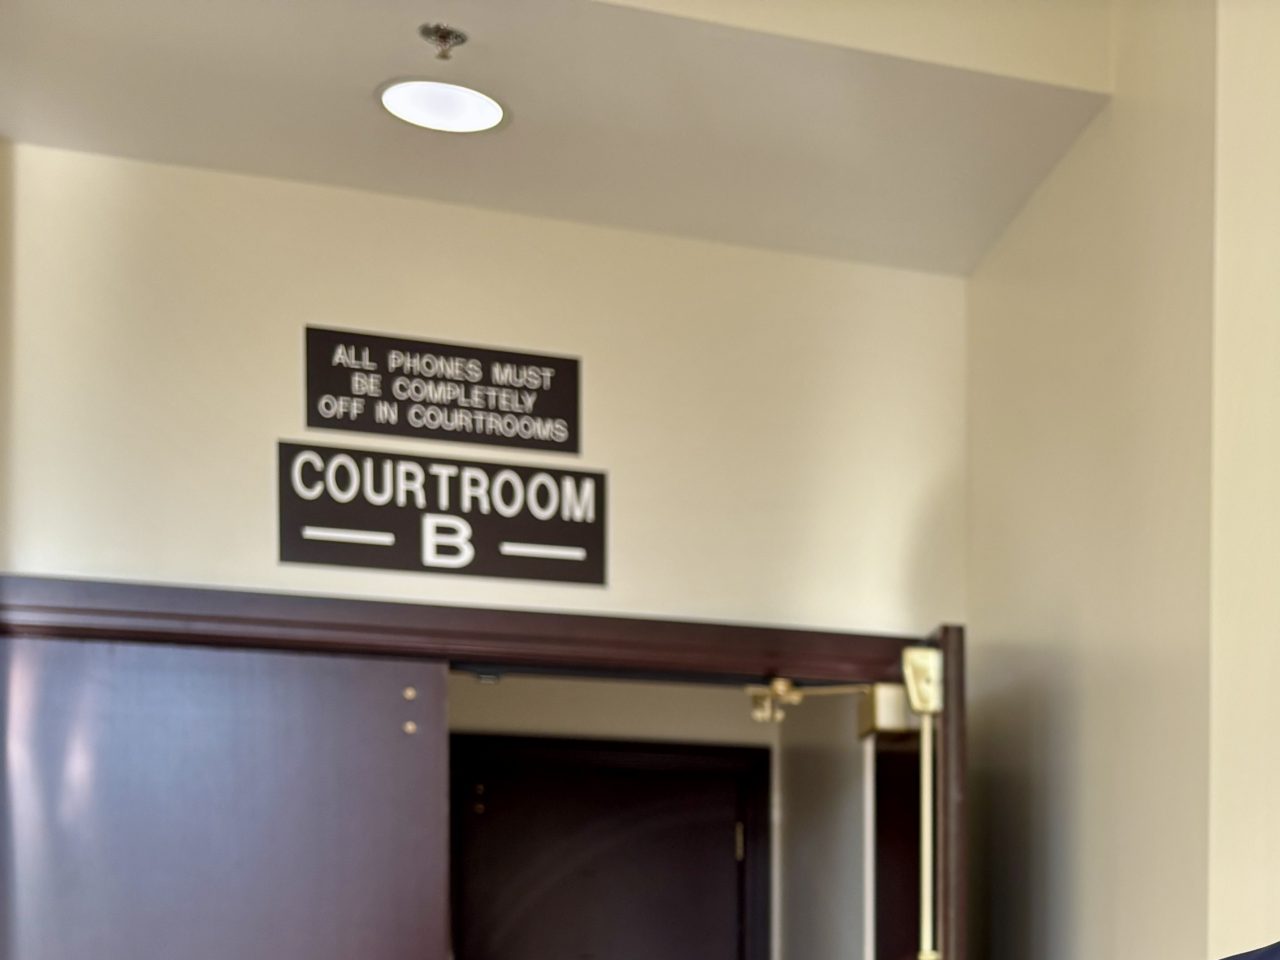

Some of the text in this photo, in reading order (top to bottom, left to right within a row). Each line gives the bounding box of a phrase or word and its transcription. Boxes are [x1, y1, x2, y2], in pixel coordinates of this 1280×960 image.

[332, 344, 555, 390] ALL PHONES MUST
[351, 372, 538, 413] BE COMPLETELY
[318, 394, 569, 443] OFF IN COURTROOMS
[291, 450, 596, 523] COURTROOM
[421, 512, 475, 568] B
